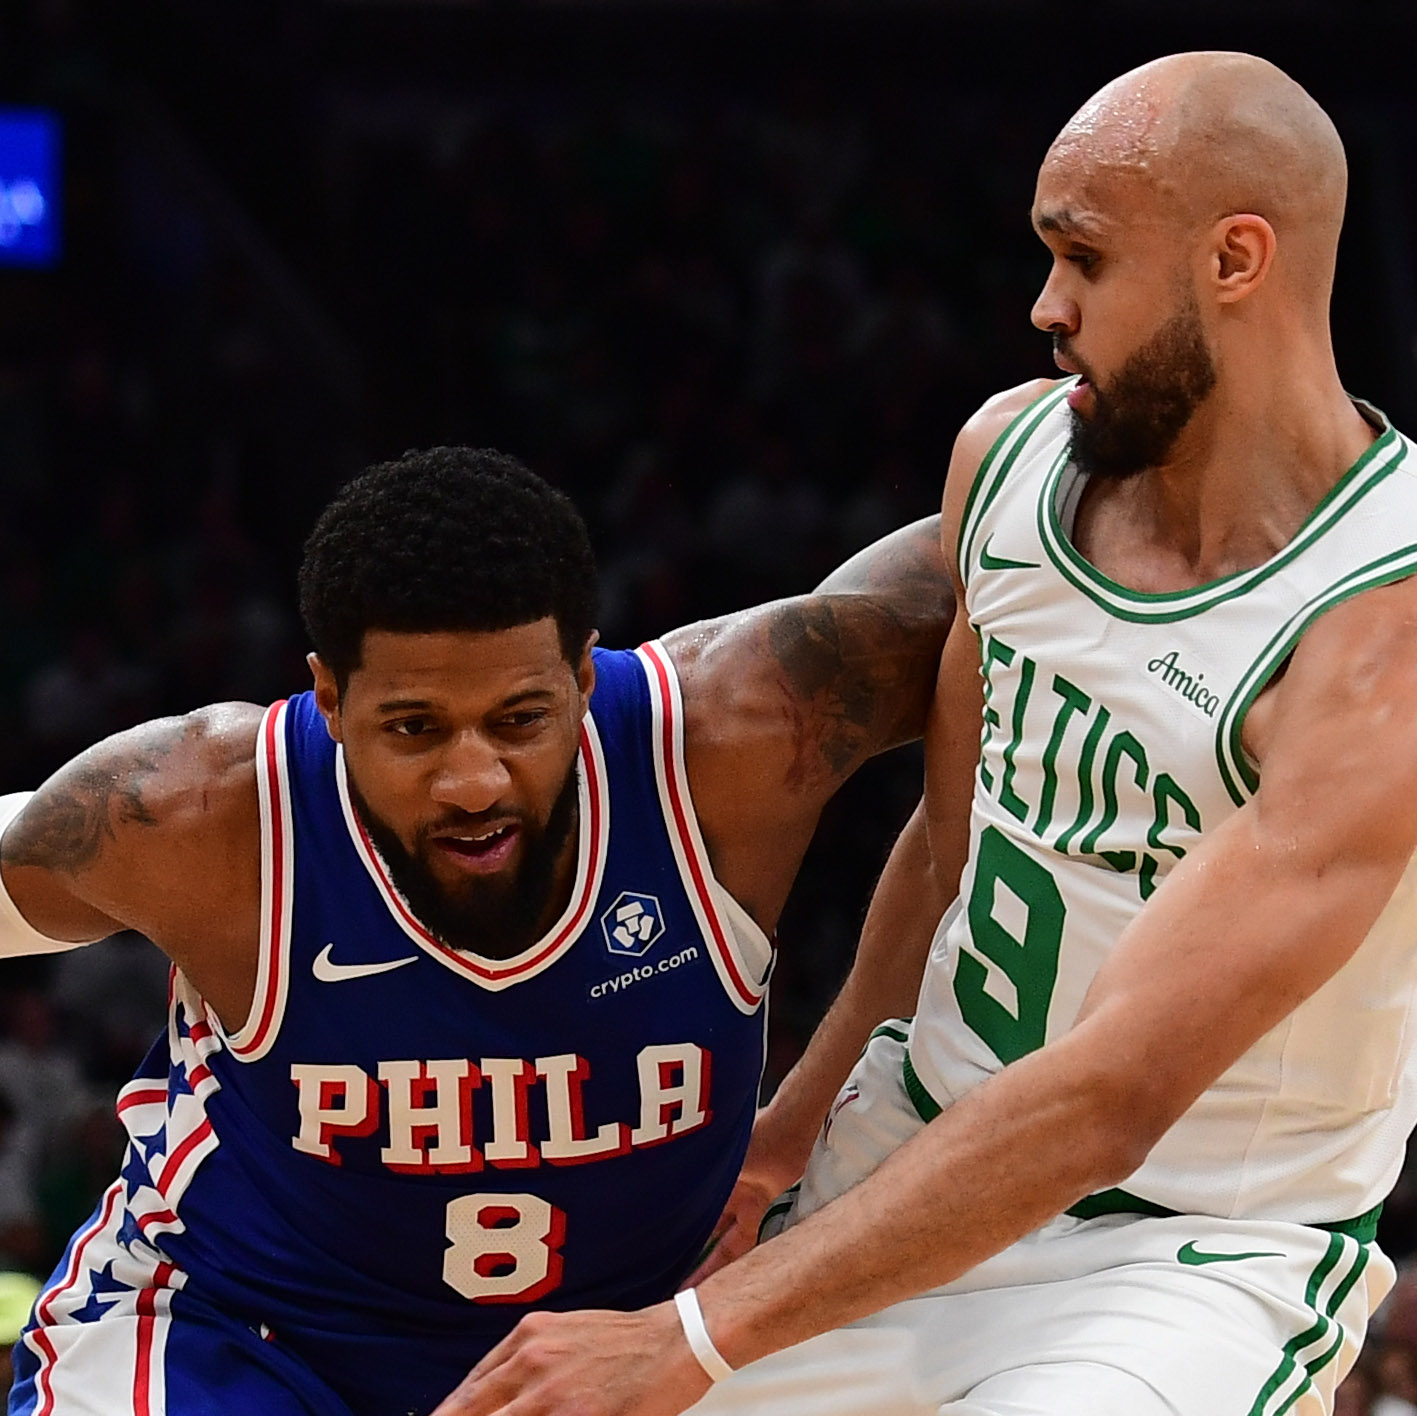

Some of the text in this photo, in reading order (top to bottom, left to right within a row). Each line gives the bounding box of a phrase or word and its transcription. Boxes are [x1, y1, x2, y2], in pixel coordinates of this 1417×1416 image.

[1147, 651, 1220, 719] Amica
[975, 627, 1202, 901] ELTICS
[590, 946, 699, 998] crypto.com
[952, 824, 1066, 1066] 9
[290, 1042, 713, 1175] PHILA
[442, 1193, 567, 1305] 8
